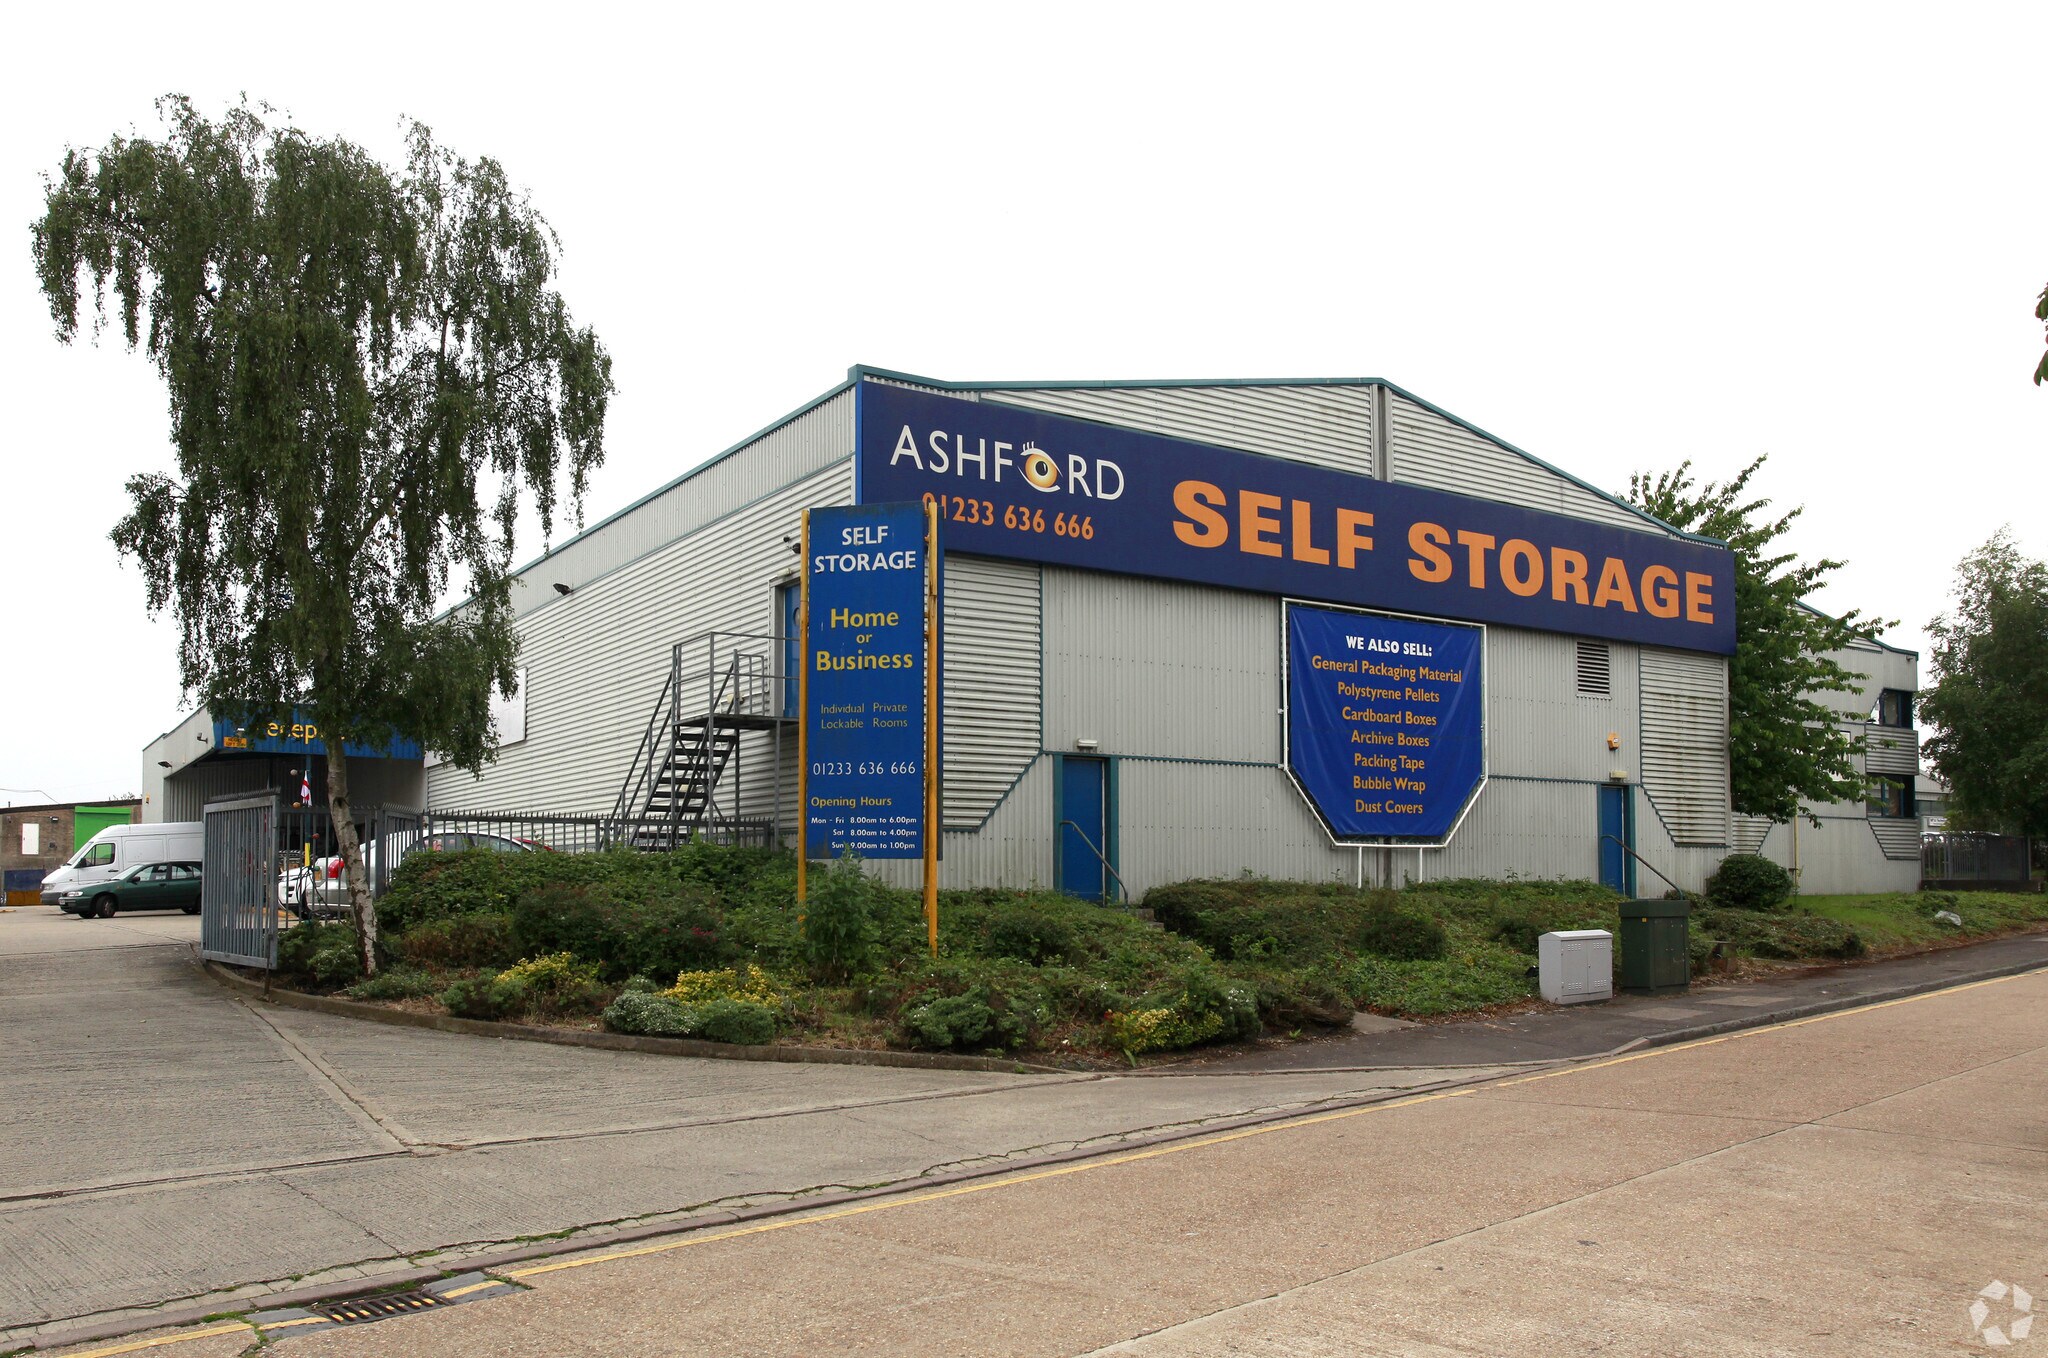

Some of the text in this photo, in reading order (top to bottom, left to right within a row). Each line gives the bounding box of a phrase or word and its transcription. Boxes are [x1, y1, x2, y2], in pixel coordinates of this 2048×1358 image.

[1004, 504, 1046, 534] 636
[1054, 512, 1094, 541] 666
[842, 525, 889, 546] SELF
[814, 550, 917, 574] STORAGE
[1172, 480, 1714, 625] SELF STORAGE
[830, 607, 899, 629] Home
[856, 633, 873, 644] or
[1346, 635, 1433, 657] WE ALSO SELL:
[816, 649, 914, 672] Business
[1312, 655, 1462, 683] General Packaging Material
[1337, 681, 1440, 703] Polystyrene Pellets
[821, 702, 908, 714] Individual Private
[1342, 706, 1437, 726] Cardboard Boxes
[821, 717, 908, 730] Lockable Rooms
[1351, 729, 1430, 747] Archive Boxes
[812, 761, 916, 776] 01233 636 666
[1354, 752, 1425, 773] Packing Tape
[1353, 775, 1426, 795] Bubble Wrap
[810, 796, 892, 809] Opening Hours
[1355, 799, 1423, 814] Dust Covers
[850, 816, 877, 824] 8.00am
[889, 816, 917, 826] 6.00pm
[889, 829, 917, 837] 4.00pm
[831, 841, 845, 849] Sun
[850, 841, 878, 849] 9.00am
[890, 841, 916, 850] 1.00pm
